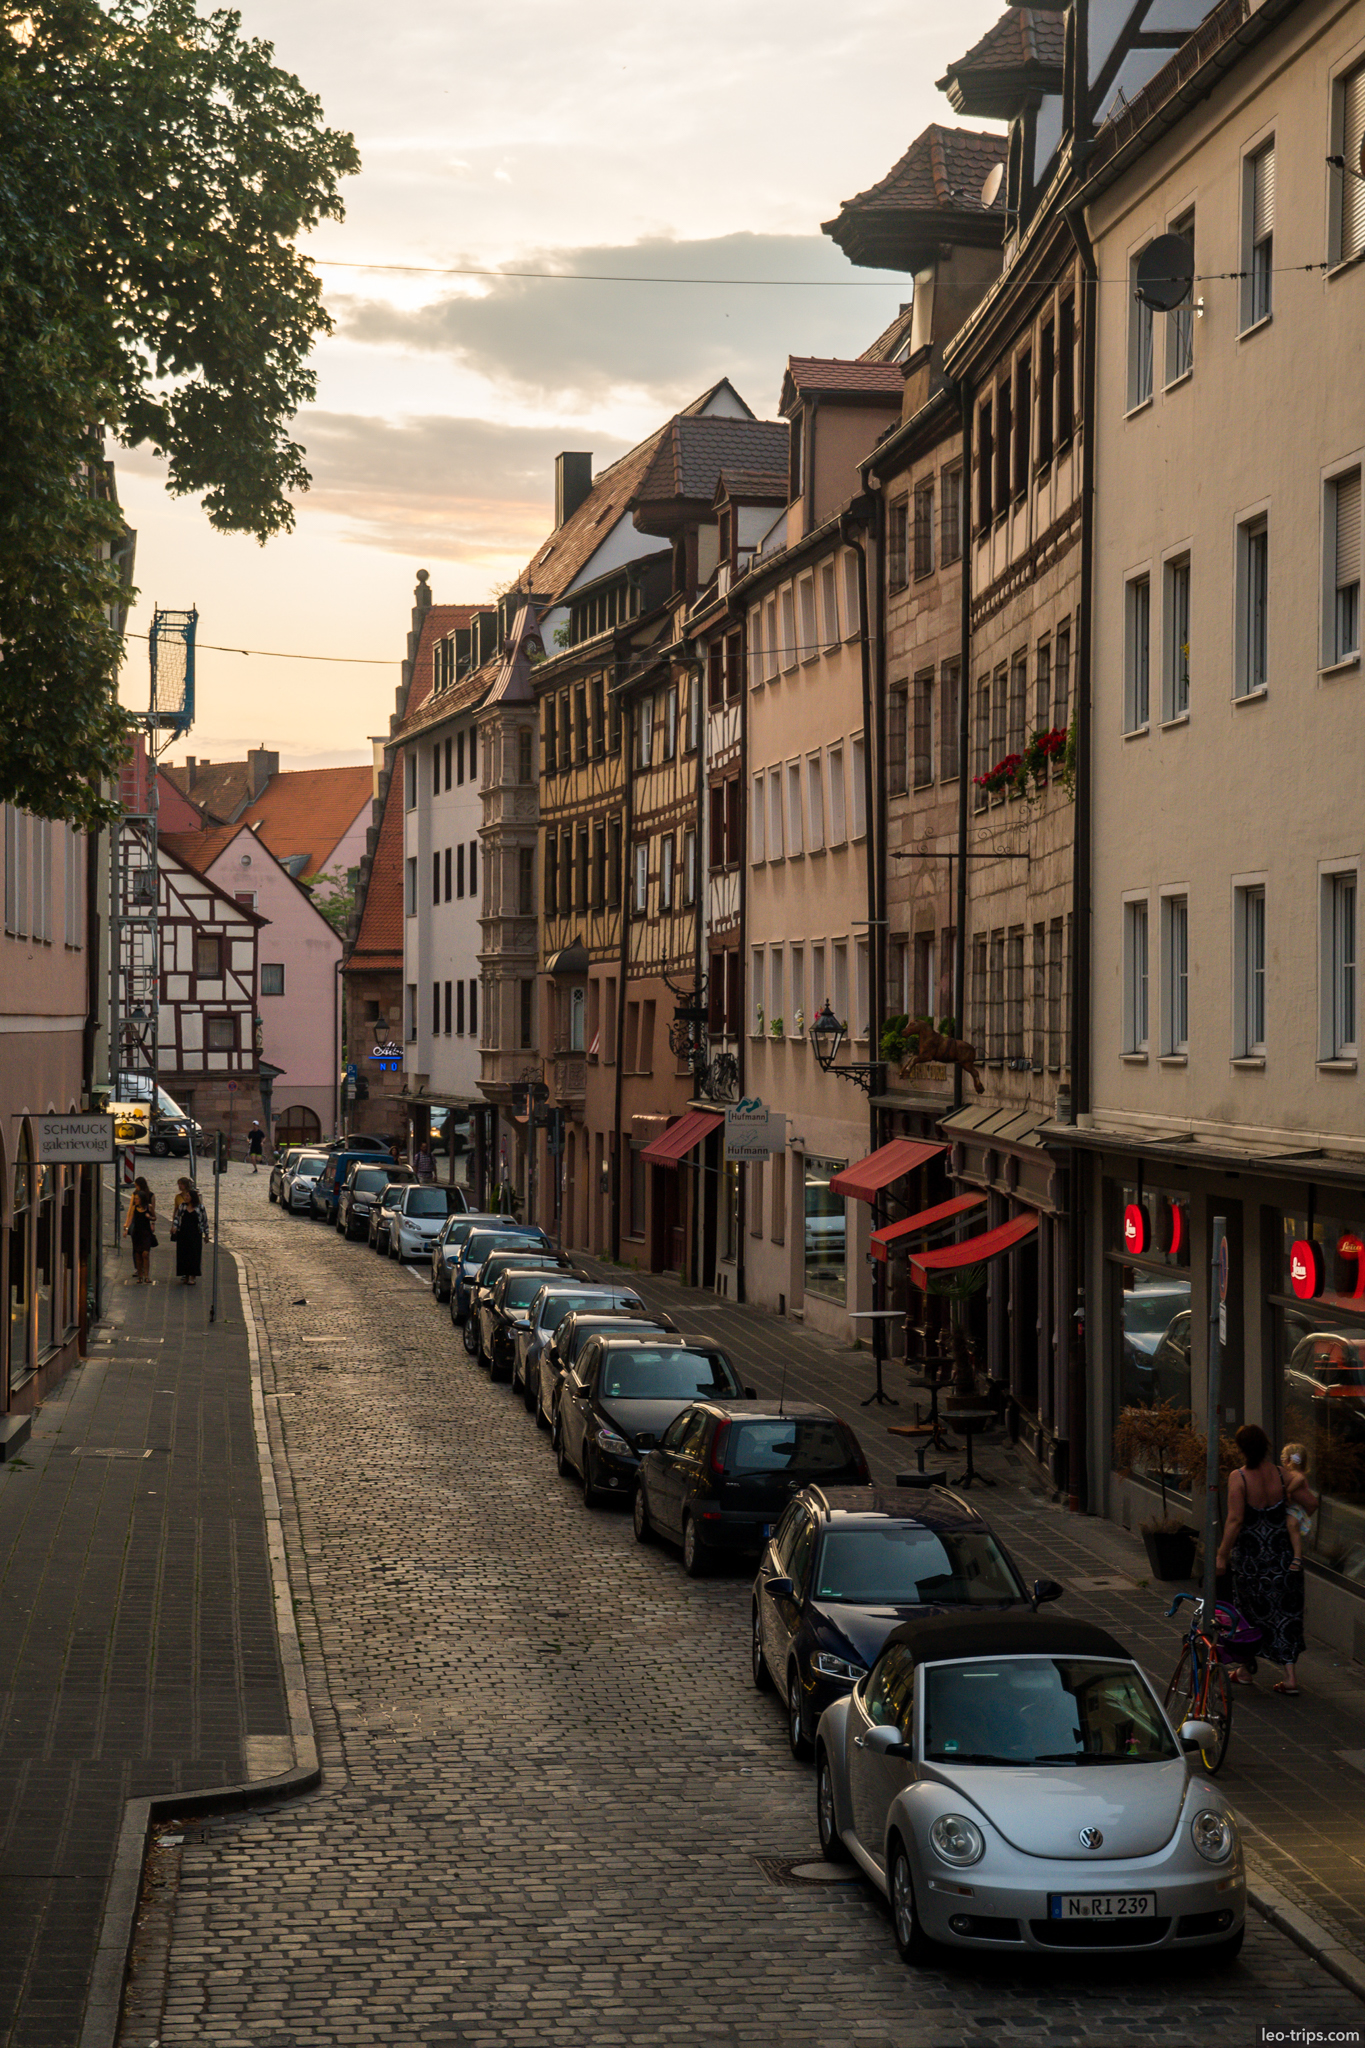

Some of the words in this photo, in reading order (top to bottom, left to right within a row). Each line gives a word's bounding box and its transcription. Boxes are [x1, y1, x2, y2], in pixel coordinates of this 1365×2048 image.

[43, 1124, 107, 1135] SCHMUCK
[42, 1137, 109, 1153] galerievoigt
[727, 1145, 769, 1154] Hufmann
[1340, 1241, 1362, 1253] Leica
[1069, 1899, 1080, 1915] N
[1091, 1898, 1113, 1915] RI
[1117, 1897, 1148, 1915] 239
